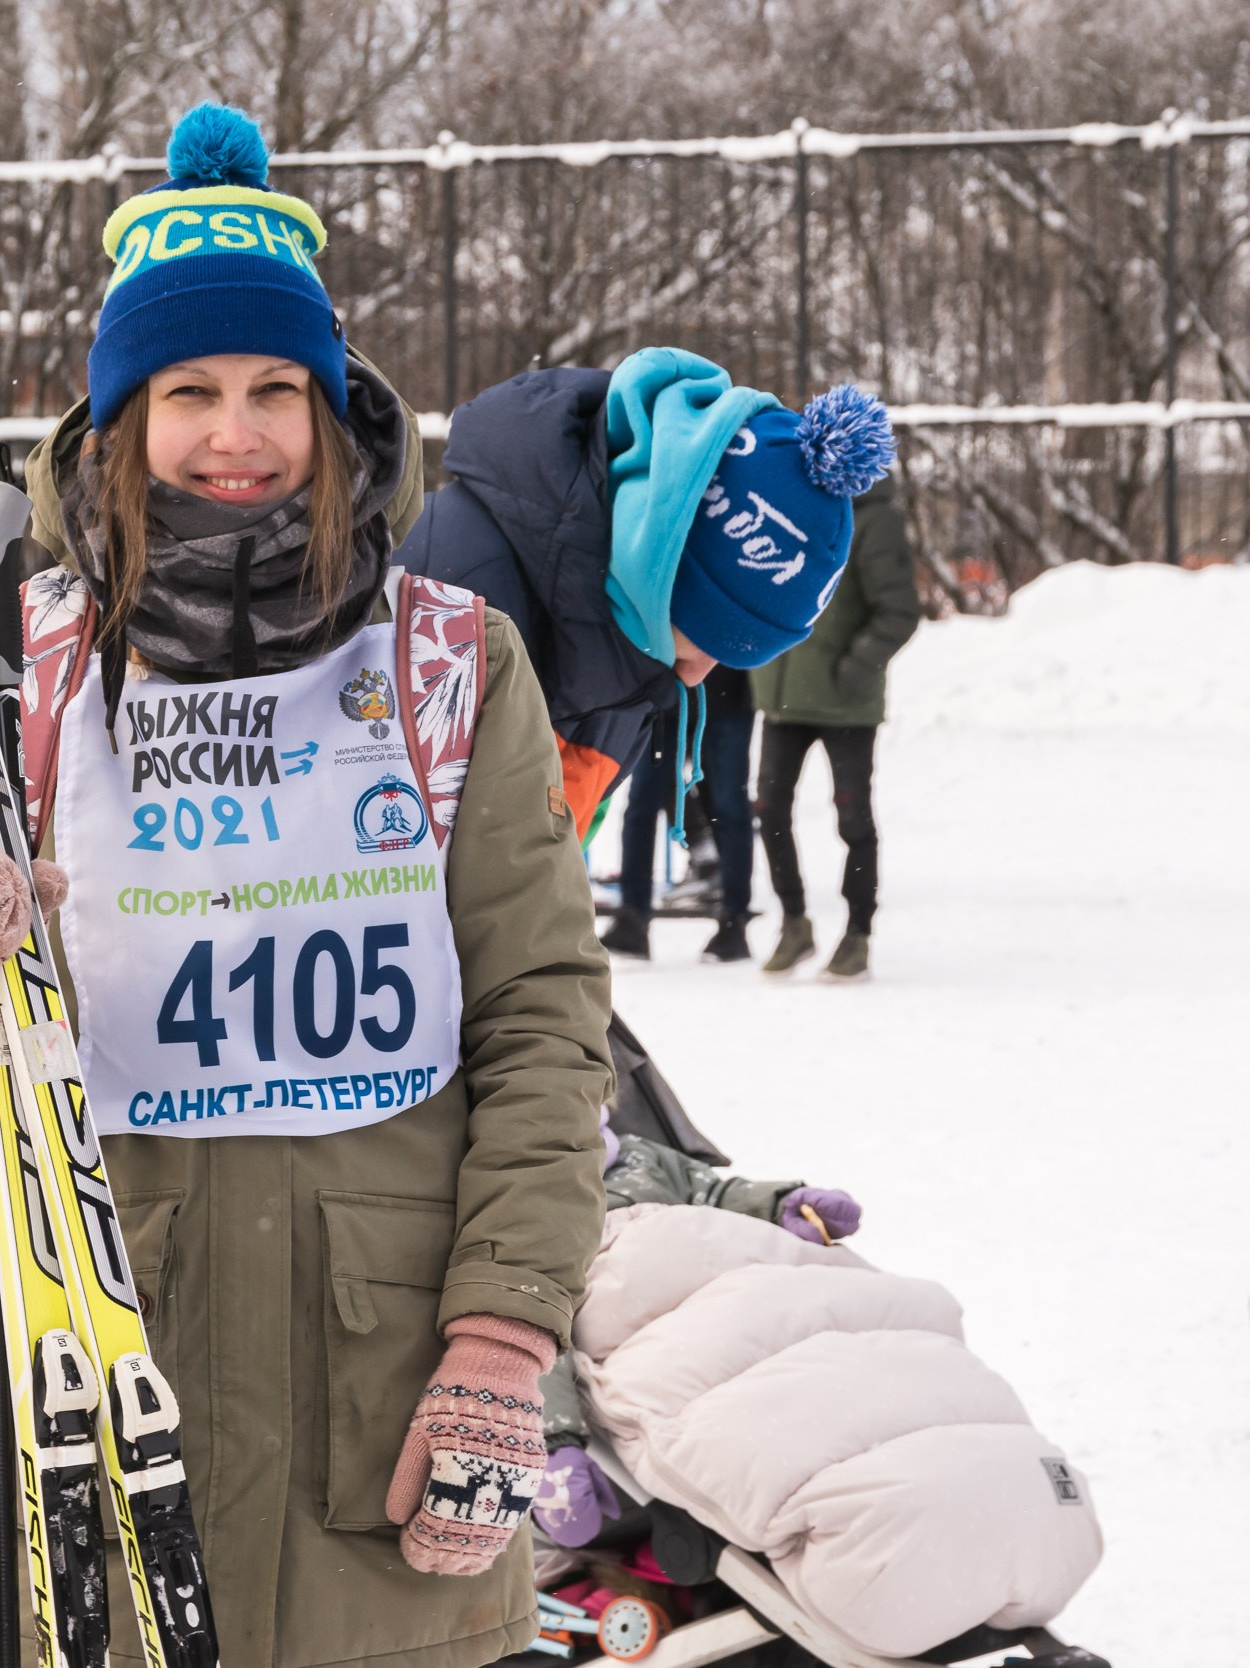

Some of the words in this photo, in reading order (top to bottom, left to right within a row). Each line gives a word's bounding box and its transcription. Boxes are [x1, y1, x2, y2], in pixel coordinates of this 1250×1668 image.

[131, 741, 281, 793] РОССИИ
[334, 753, 386, 766] РОССИЙСКОЙ
[335, 743, 395, 757] МИНИСТЕРСТВО
[126, 794, 281, 852] 2021
[117, 886, 212, 917] СПОРТ
[231, 873, 340, 913] НОРМА
[341, 863, 438, 899] ЖИЗНИ
[156, 922, 417, 1068] 4105
[128, 1065, 438, 1127] САНКТ-ПЕТЕРБУРГ
